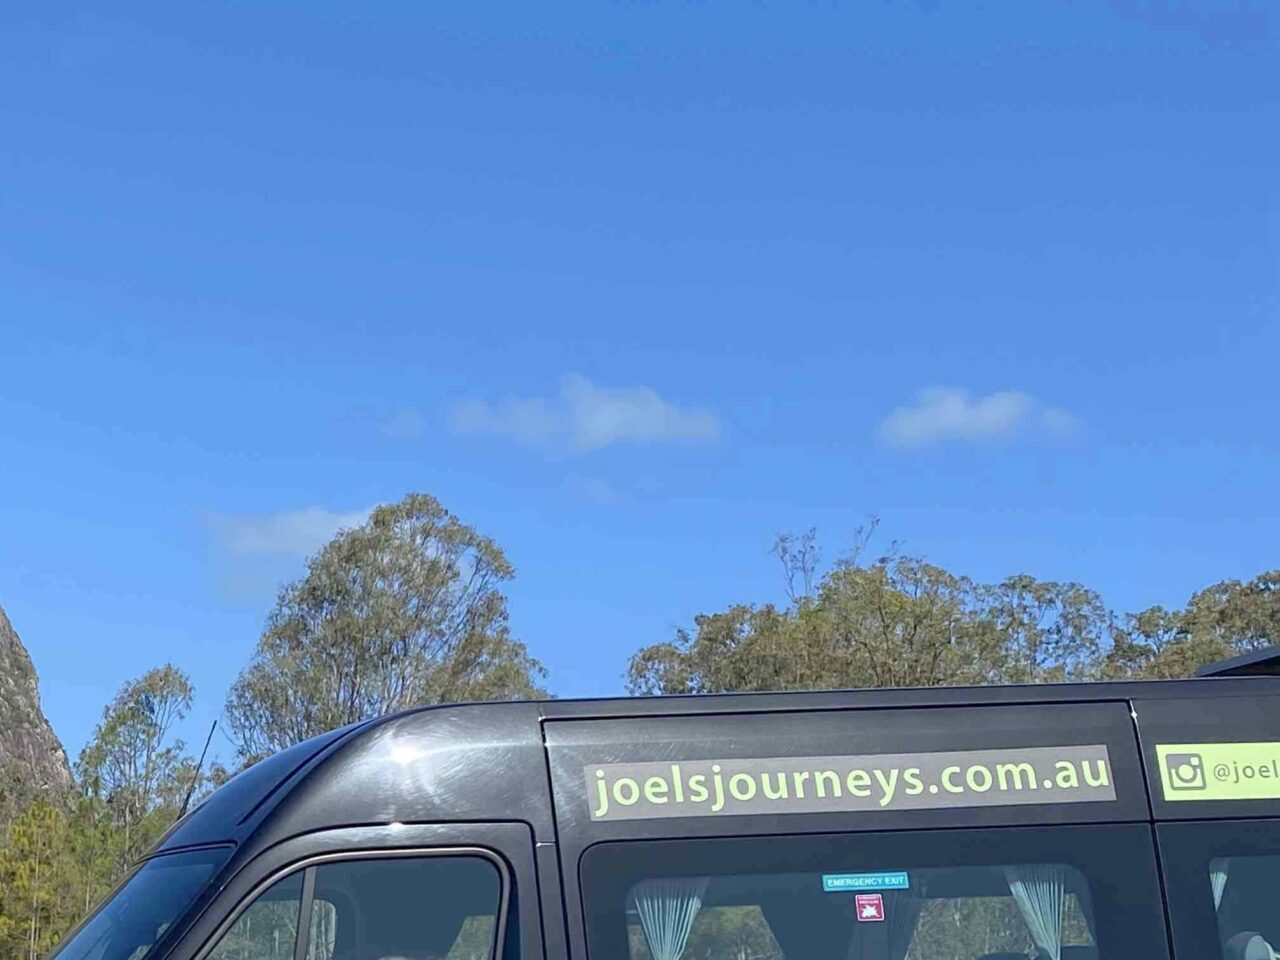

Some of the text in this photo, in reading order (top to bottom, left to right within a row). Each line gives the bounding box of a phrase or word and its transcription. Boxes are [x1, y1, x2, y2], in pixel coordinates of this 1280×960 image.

[594, 759, 1110, 818] joelsjourneys.com.au
[827, 876, 904, 887] EMERGENCY EXIT
